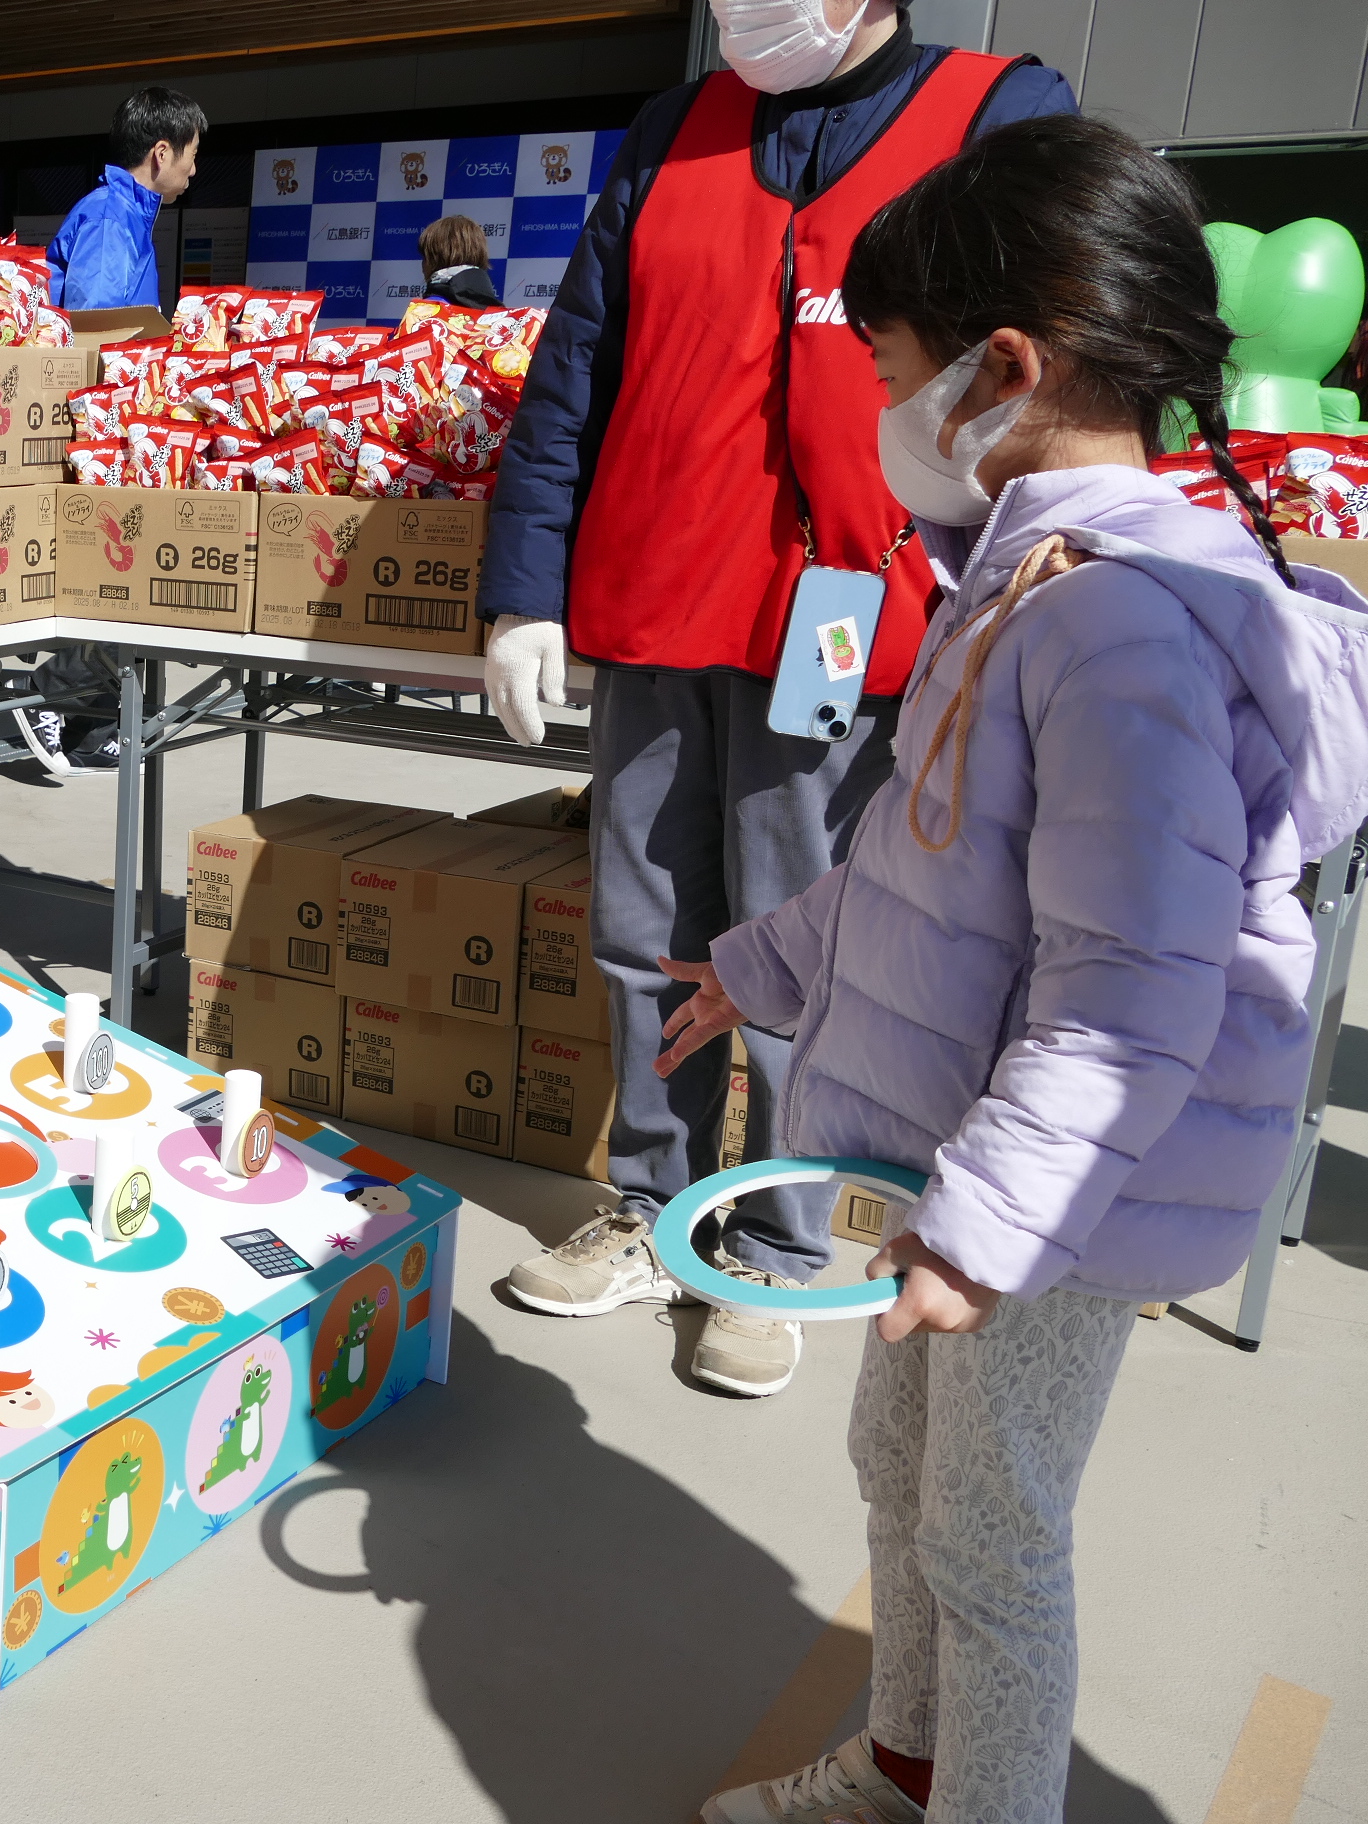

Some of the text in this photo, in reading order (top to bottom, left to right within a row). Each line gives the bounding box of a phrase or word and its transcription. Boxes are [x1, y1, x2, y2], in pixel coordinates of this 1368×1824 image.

[333, 169, 374, 182] ひろぎん
[466, 162, 512, 176] ひろぎん
[327, 227, 370, 240] 広島銀行
[482, 224, 506, 236] 銀行
[325, 285, 364, 298] ひろぎん
[308, 372, 331, 380] Calbee
[482, 402, 504, 420] Calbee
[149, 426, 168, 434] Calbee
[385, 451, 408, 465] Calbee
[191, 546, 239, 575] 26g
[414, 560, 470, 591] 26g
[102, 589, 126, 598] 28846
[264, 604, 304, 614] 賞味期限/LOT
[309, 605, 339, 616] 28846
[196, 841, 237, 860] Calbee
[199, 870, 229, 883] 10593
[351, 871, 397, 891] Calbee
[207, 884, 220, 893] 26g
[353, 902, 387, 915] 10593
[534, 898, 585, 918] Calbee
[198, 915, 228, 928] 28846
[361, 917, 376, 926] 26g
[537, 929, 574, 944] 10593
[349, 950, 384, 964] 28846
[546, 945, 562, 955] 26g
[197, 972, 237, 991] Calbee
[534, 979, 571, 994] 28846
[200, 999, 230, 1013] 10593
[356, 1002, 400, 1023] Calbee
[208, 1013, 221, 1022] 26g
[358, 1031, 391, 1046] 10593
[199, 1042, 229, 1056] 28846
[366, 1046, 380, 1056] 26g
[532, 1039, 580, 1061] Calbee
[91, 1046, 109, 1083] 100
[533, 1069, 570, 1085] 10593
[356, 1077, 389, 1092] 28846
[543, 1085, 558, 1095] 26g
[530, 1117, 567, 1134] 28846
[251, 1128, 268, 1161] 10
[130, 1177, 139, 1199] 5
